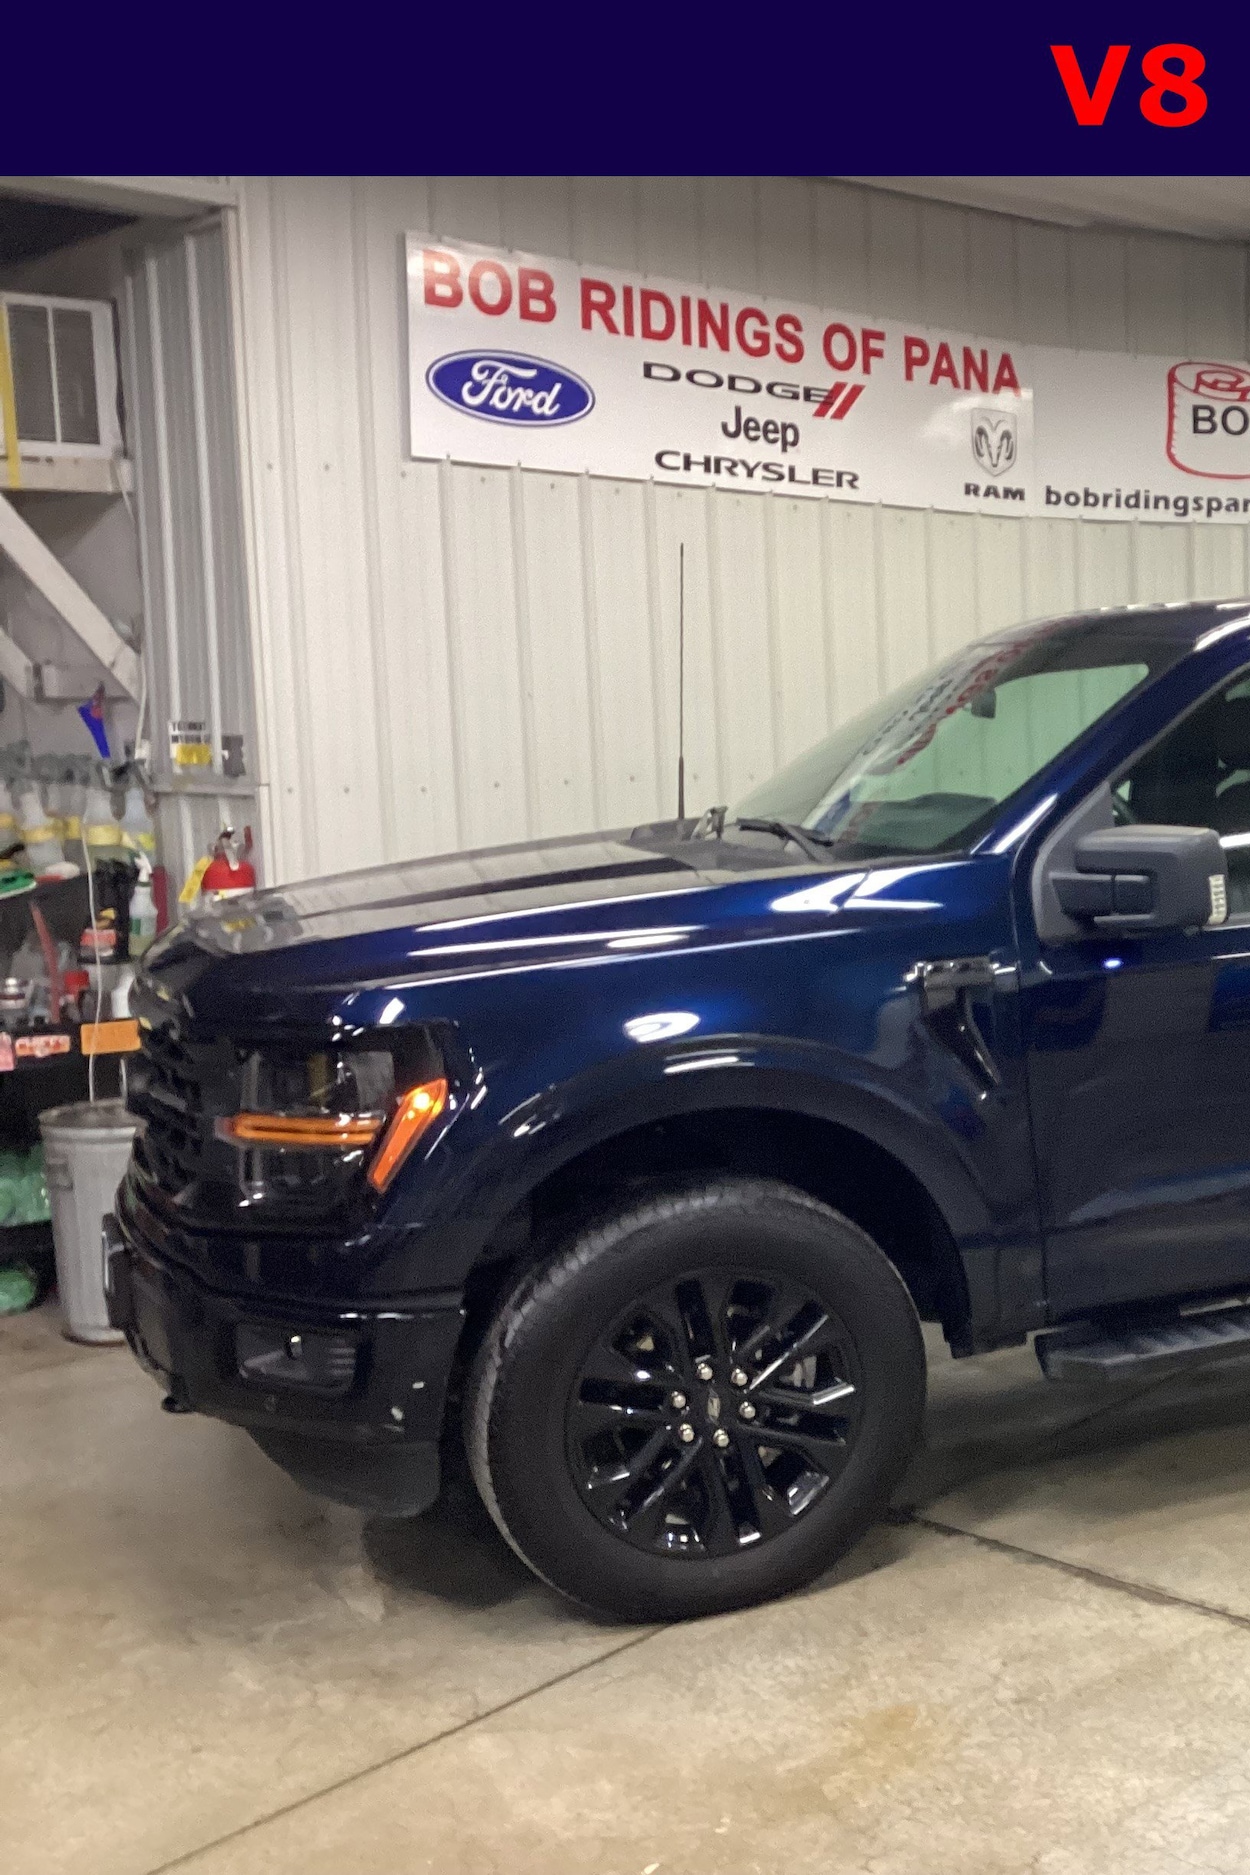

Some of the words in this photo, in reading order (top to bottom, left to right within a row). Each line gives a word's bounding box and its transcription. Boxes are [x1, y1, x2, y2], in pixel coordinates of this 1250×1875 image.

[423, 248, 558, 325] BOB
[579, 276, 806, 365] RIDINGS
[822, 321, 887, 376] OF
[902, 334, 1021, 397] PANA
[460, 359, 561, 419] Ford
[642, 361, 837, 405] DODGE
[721, 405, 800, 453] Jeep
[654, 450, 860, 490] CHRYSLER
[963, 482, 1026, 502] RAM
